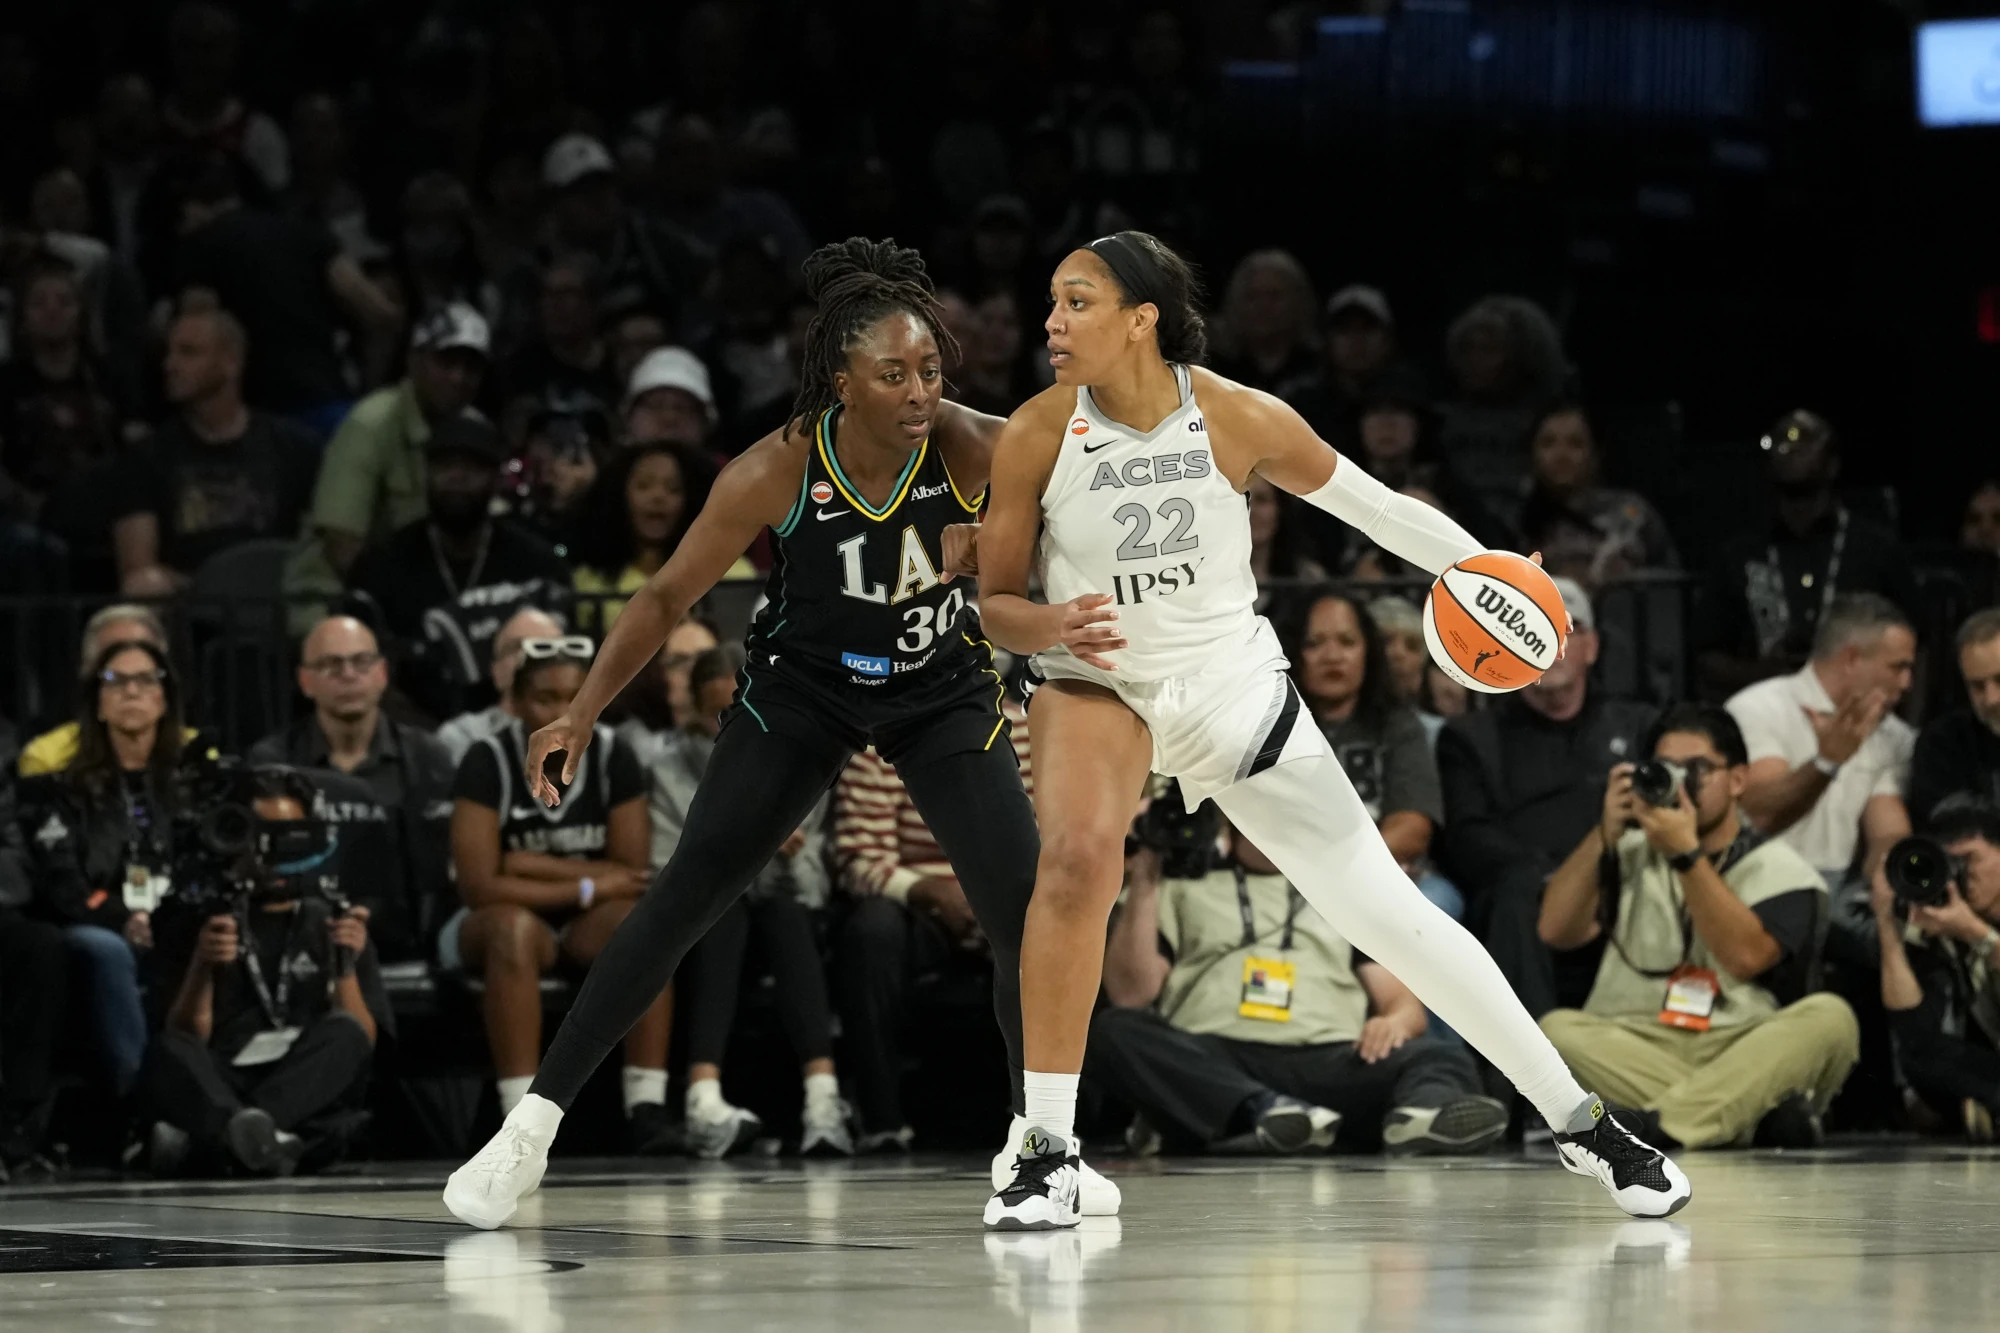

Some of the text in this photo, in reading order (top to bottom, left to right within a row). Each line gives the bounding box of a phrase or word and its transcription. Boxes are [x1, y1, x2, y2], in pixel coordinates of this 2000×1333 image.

[910, 481, 949, 501] Albert
[1089, 450, 1211, 490] ACES
[1113, 497, 1199, 561] 22
[837, 524, 942, 605] LA
[1112, 556, 1205, 605] IPSY
[897, 587, 964, 652] 30
[1475, 584, 1547, 659] Wilson
[847, 658, 883, 672] UCLA
